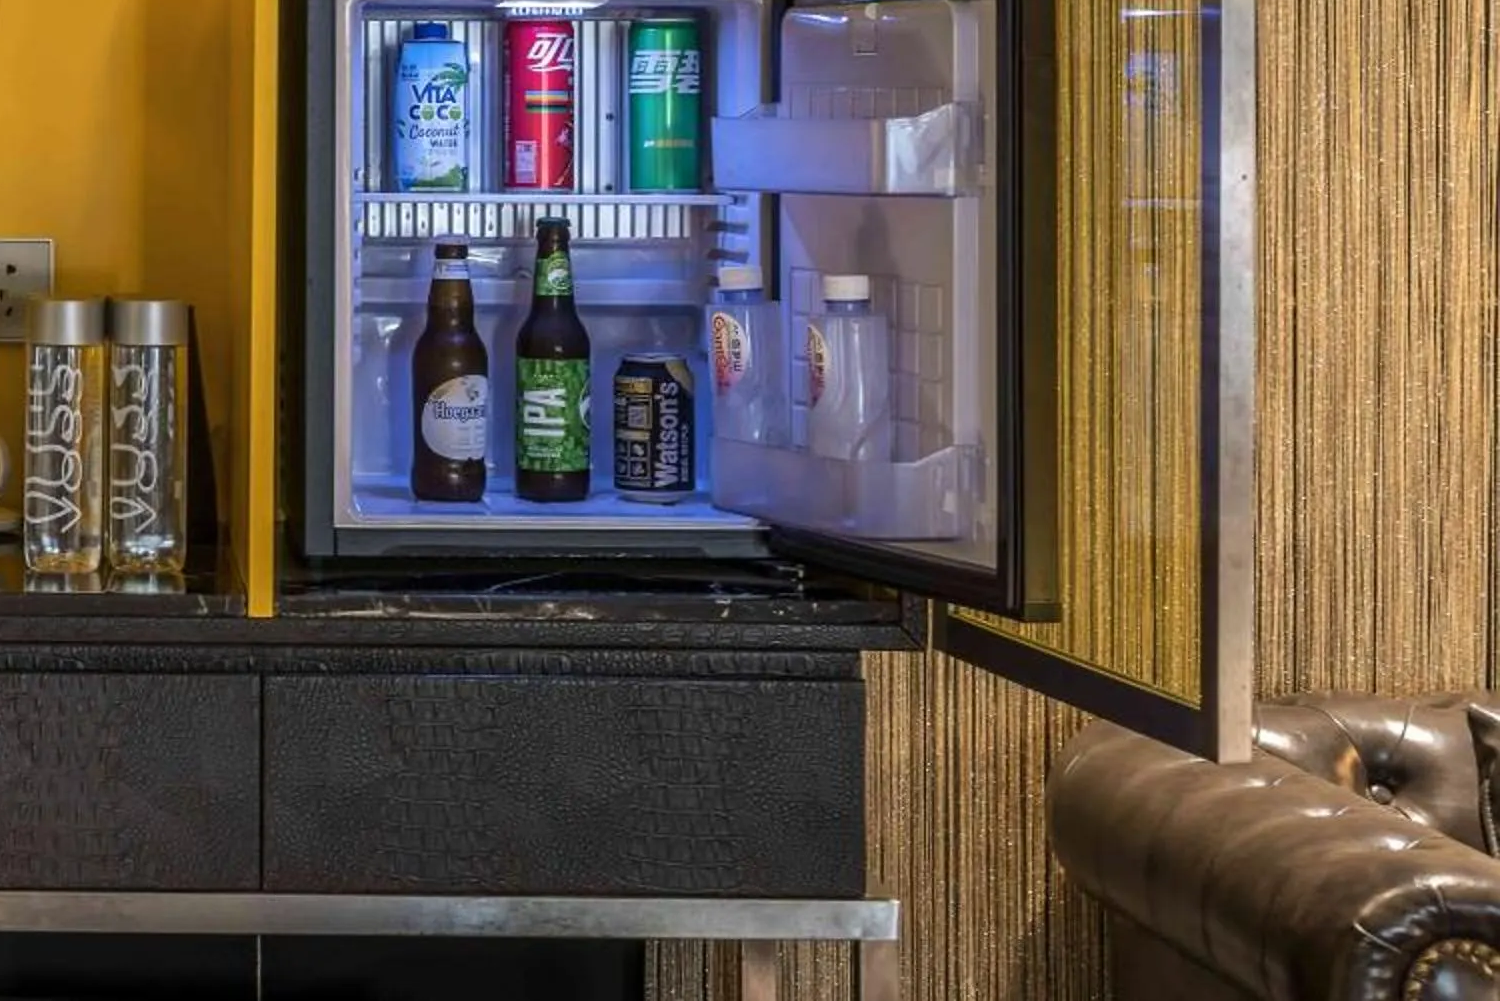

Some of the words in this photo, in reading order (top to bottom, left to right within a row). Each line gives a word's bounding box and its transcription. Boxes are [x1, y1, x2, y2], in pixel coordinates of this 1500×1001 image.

[411, 82, 457, 104] VITA
[409, 104, 462, 121] COCO
[409, 124, 460, 139] Coconut
[523, 388, 566, 437] IPA
[653, 382, 679, 488] Watson's
